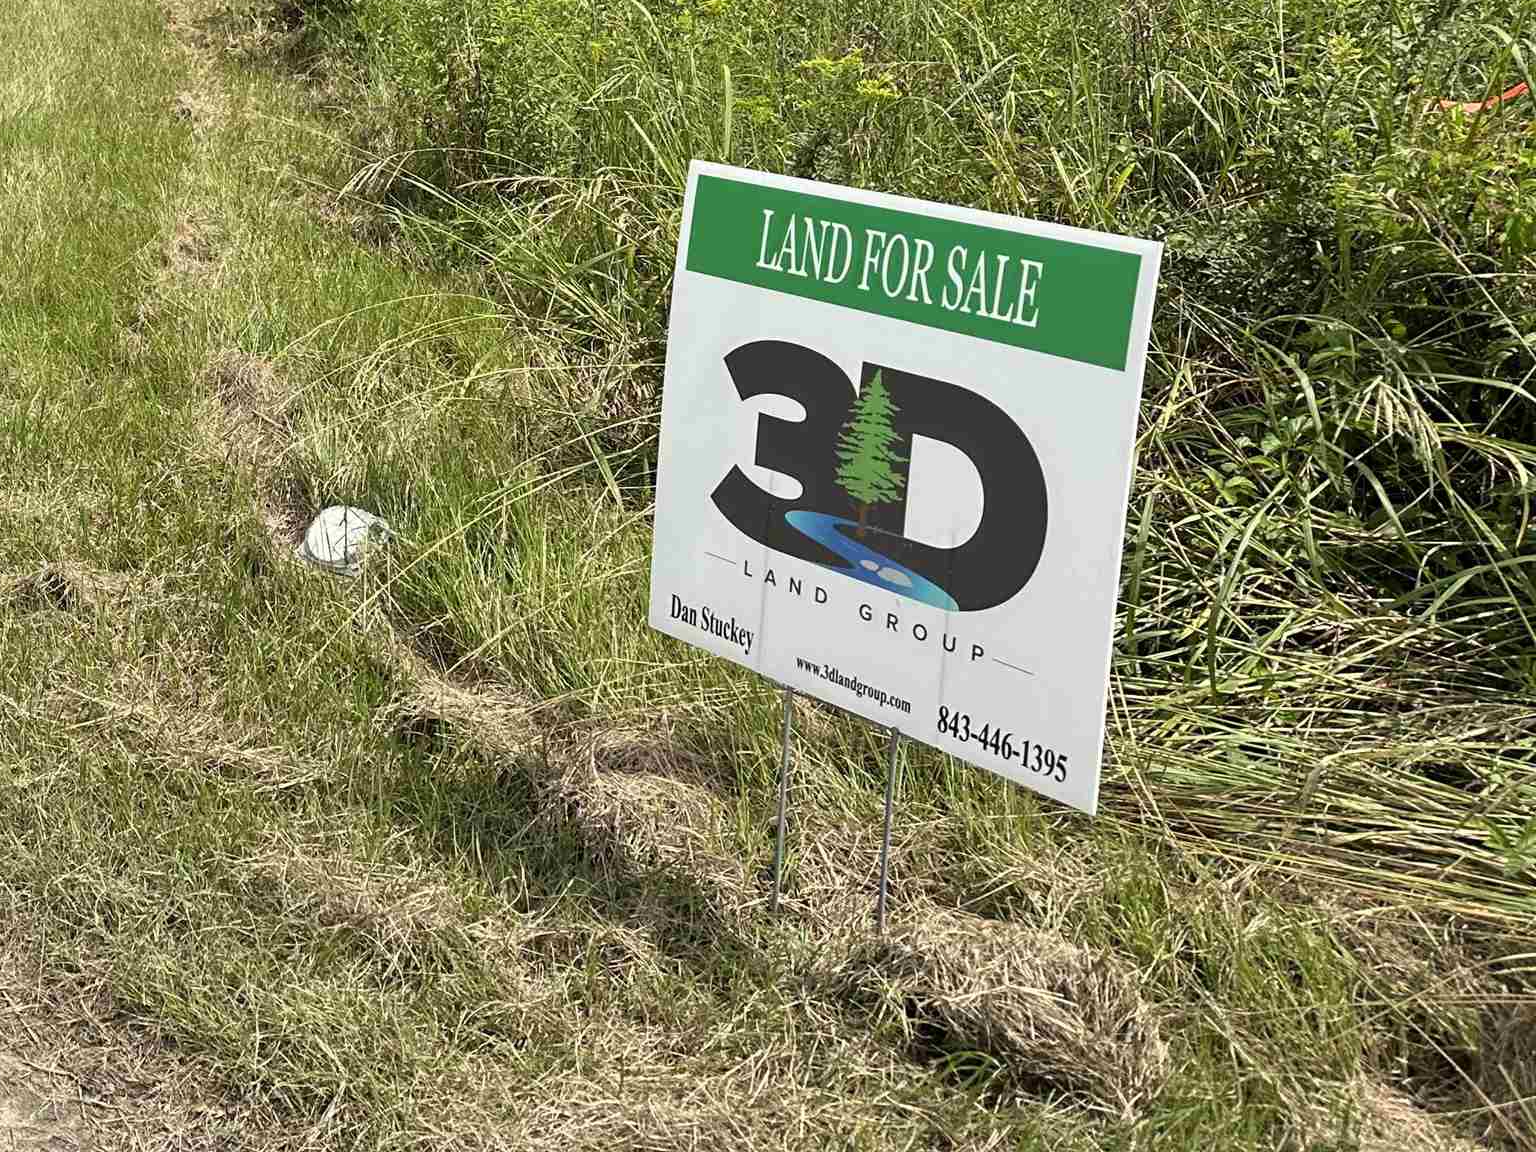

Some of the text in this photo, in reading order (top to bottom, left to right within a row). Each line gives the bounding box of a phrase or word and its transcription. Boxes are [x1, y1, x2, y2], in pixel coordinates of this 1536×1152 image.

[756, 209, 1044, 328] LAND FOR SALE
[710, 339, 1049, 612] 3D
[670, 593, 754, 654] Dan Stuckey
[743, 560, 984, 661] LAND GROUP
[796, 656, 912, 715] www.3dlandgroup.com
[937, 705, 1068, 783] 843-446-1395
